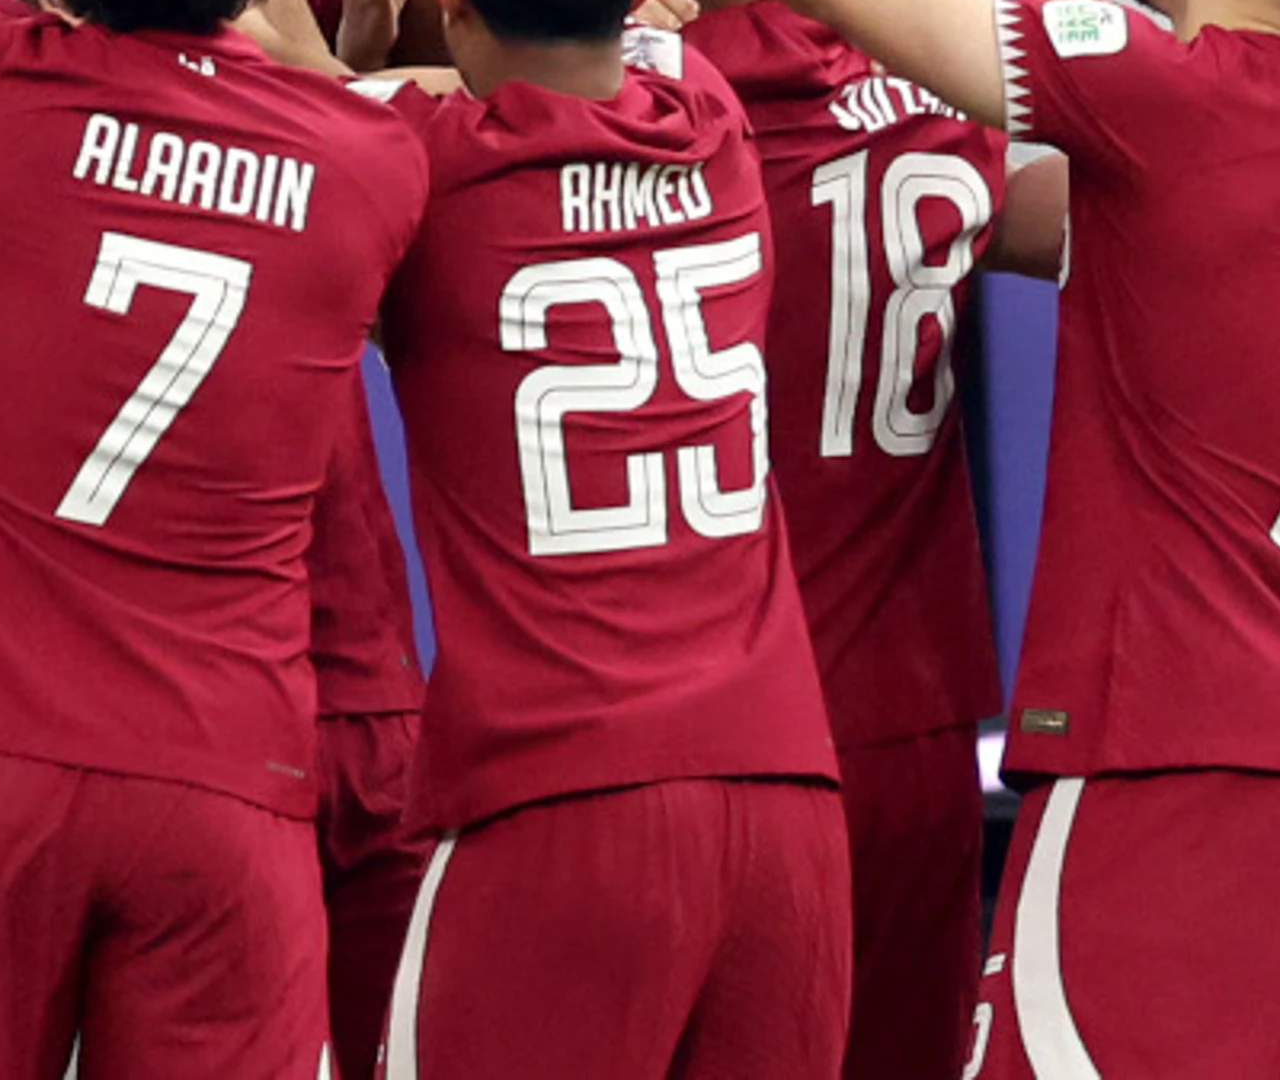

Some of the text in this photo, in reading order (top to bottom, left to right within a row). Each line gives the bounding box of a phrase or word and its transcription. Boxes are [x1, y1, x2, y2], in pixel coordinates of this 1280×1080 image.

[72, 113, 316, 233] ALAADIN
[560, 162, 714, 234] AHMED
[811, 149, 992, 457] 18
[55, 231, 253, 526] 7
[499, 232, 770, 556] 25
